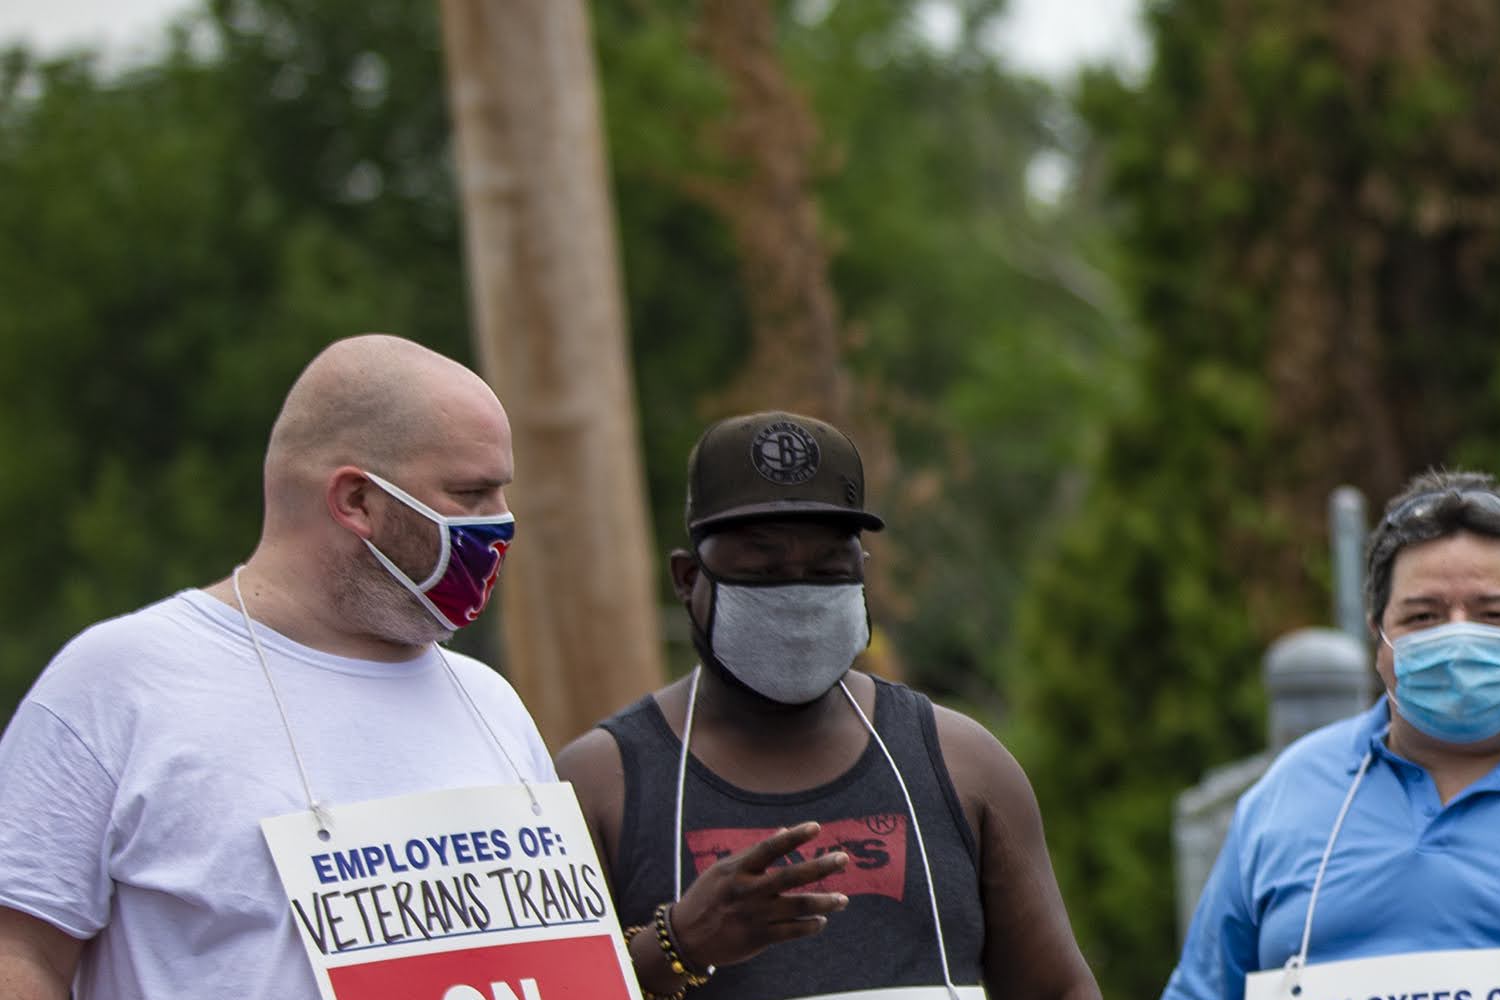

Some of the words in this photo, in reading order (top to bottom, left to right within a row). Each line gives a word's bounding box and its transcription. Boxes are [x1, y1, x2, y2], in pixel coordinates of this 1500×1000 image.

[311, 829, 512, 884] EMPLOYEES
[518, 826, 567, 858] OF:
[292, 872, 491, 955] VETERANS
[487, 863, 606, 928] TRANS
